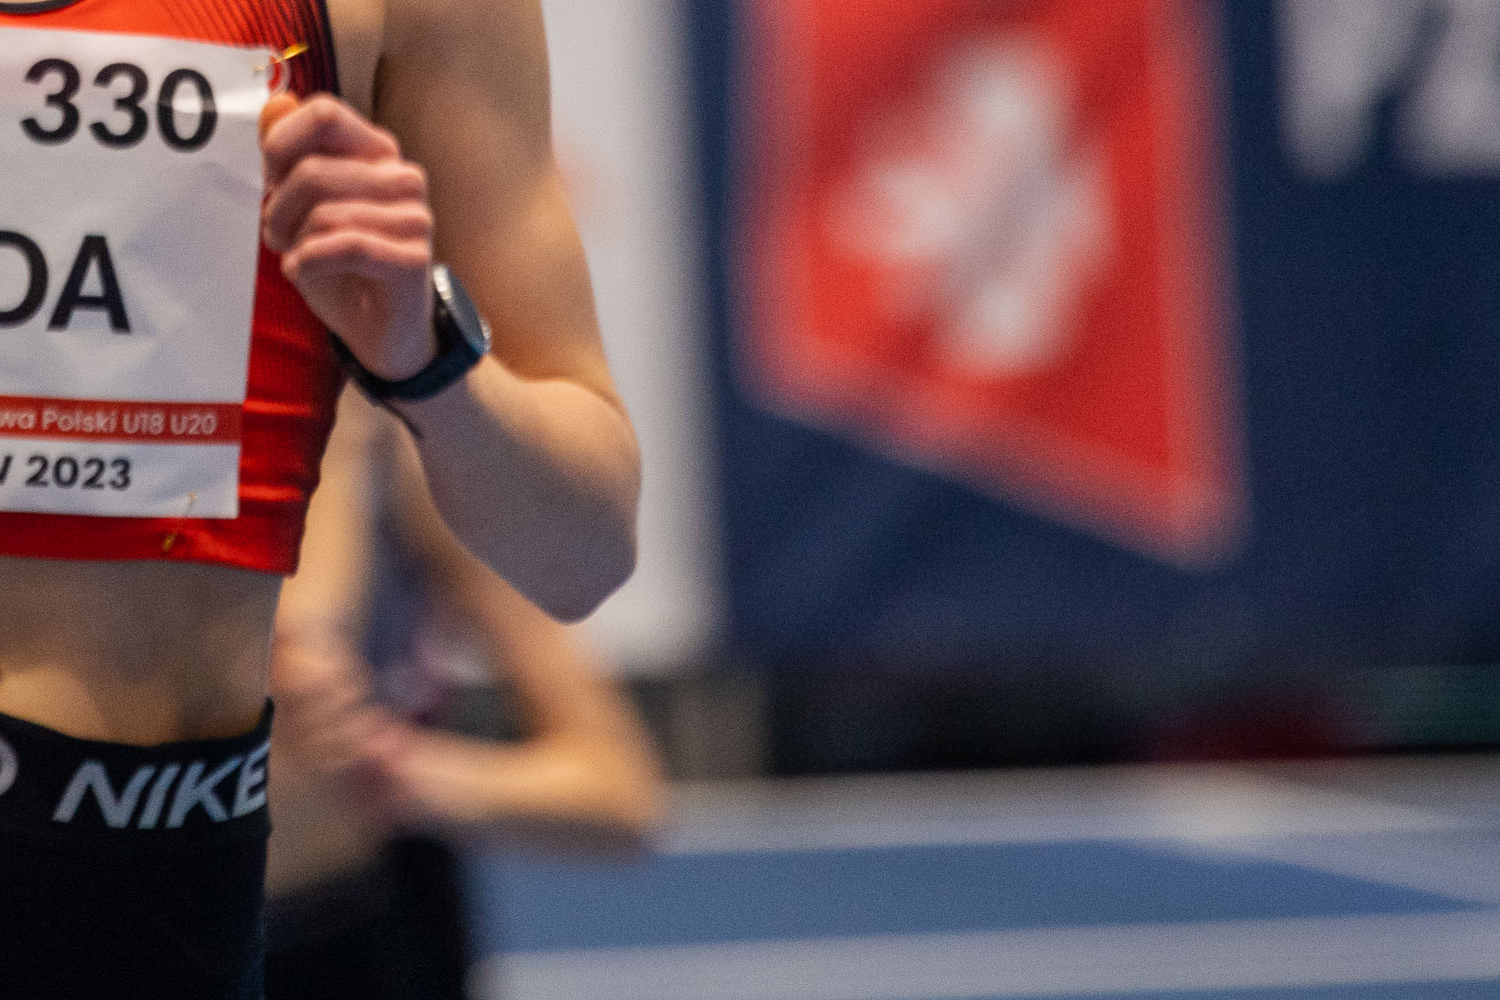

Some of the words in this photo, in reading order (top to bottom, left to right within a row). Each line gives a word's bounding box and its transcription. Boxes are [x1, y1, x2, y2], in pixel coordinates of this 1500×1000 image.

[20, 58, 219, 153] 330
[41, 407, 118, 434] Polski
[121, 411, 165, 435] U18
[169, 411, 218, 436] U20
[25, 455, 131, 491] 2023
[51, 740, 272, 830] NIKE
